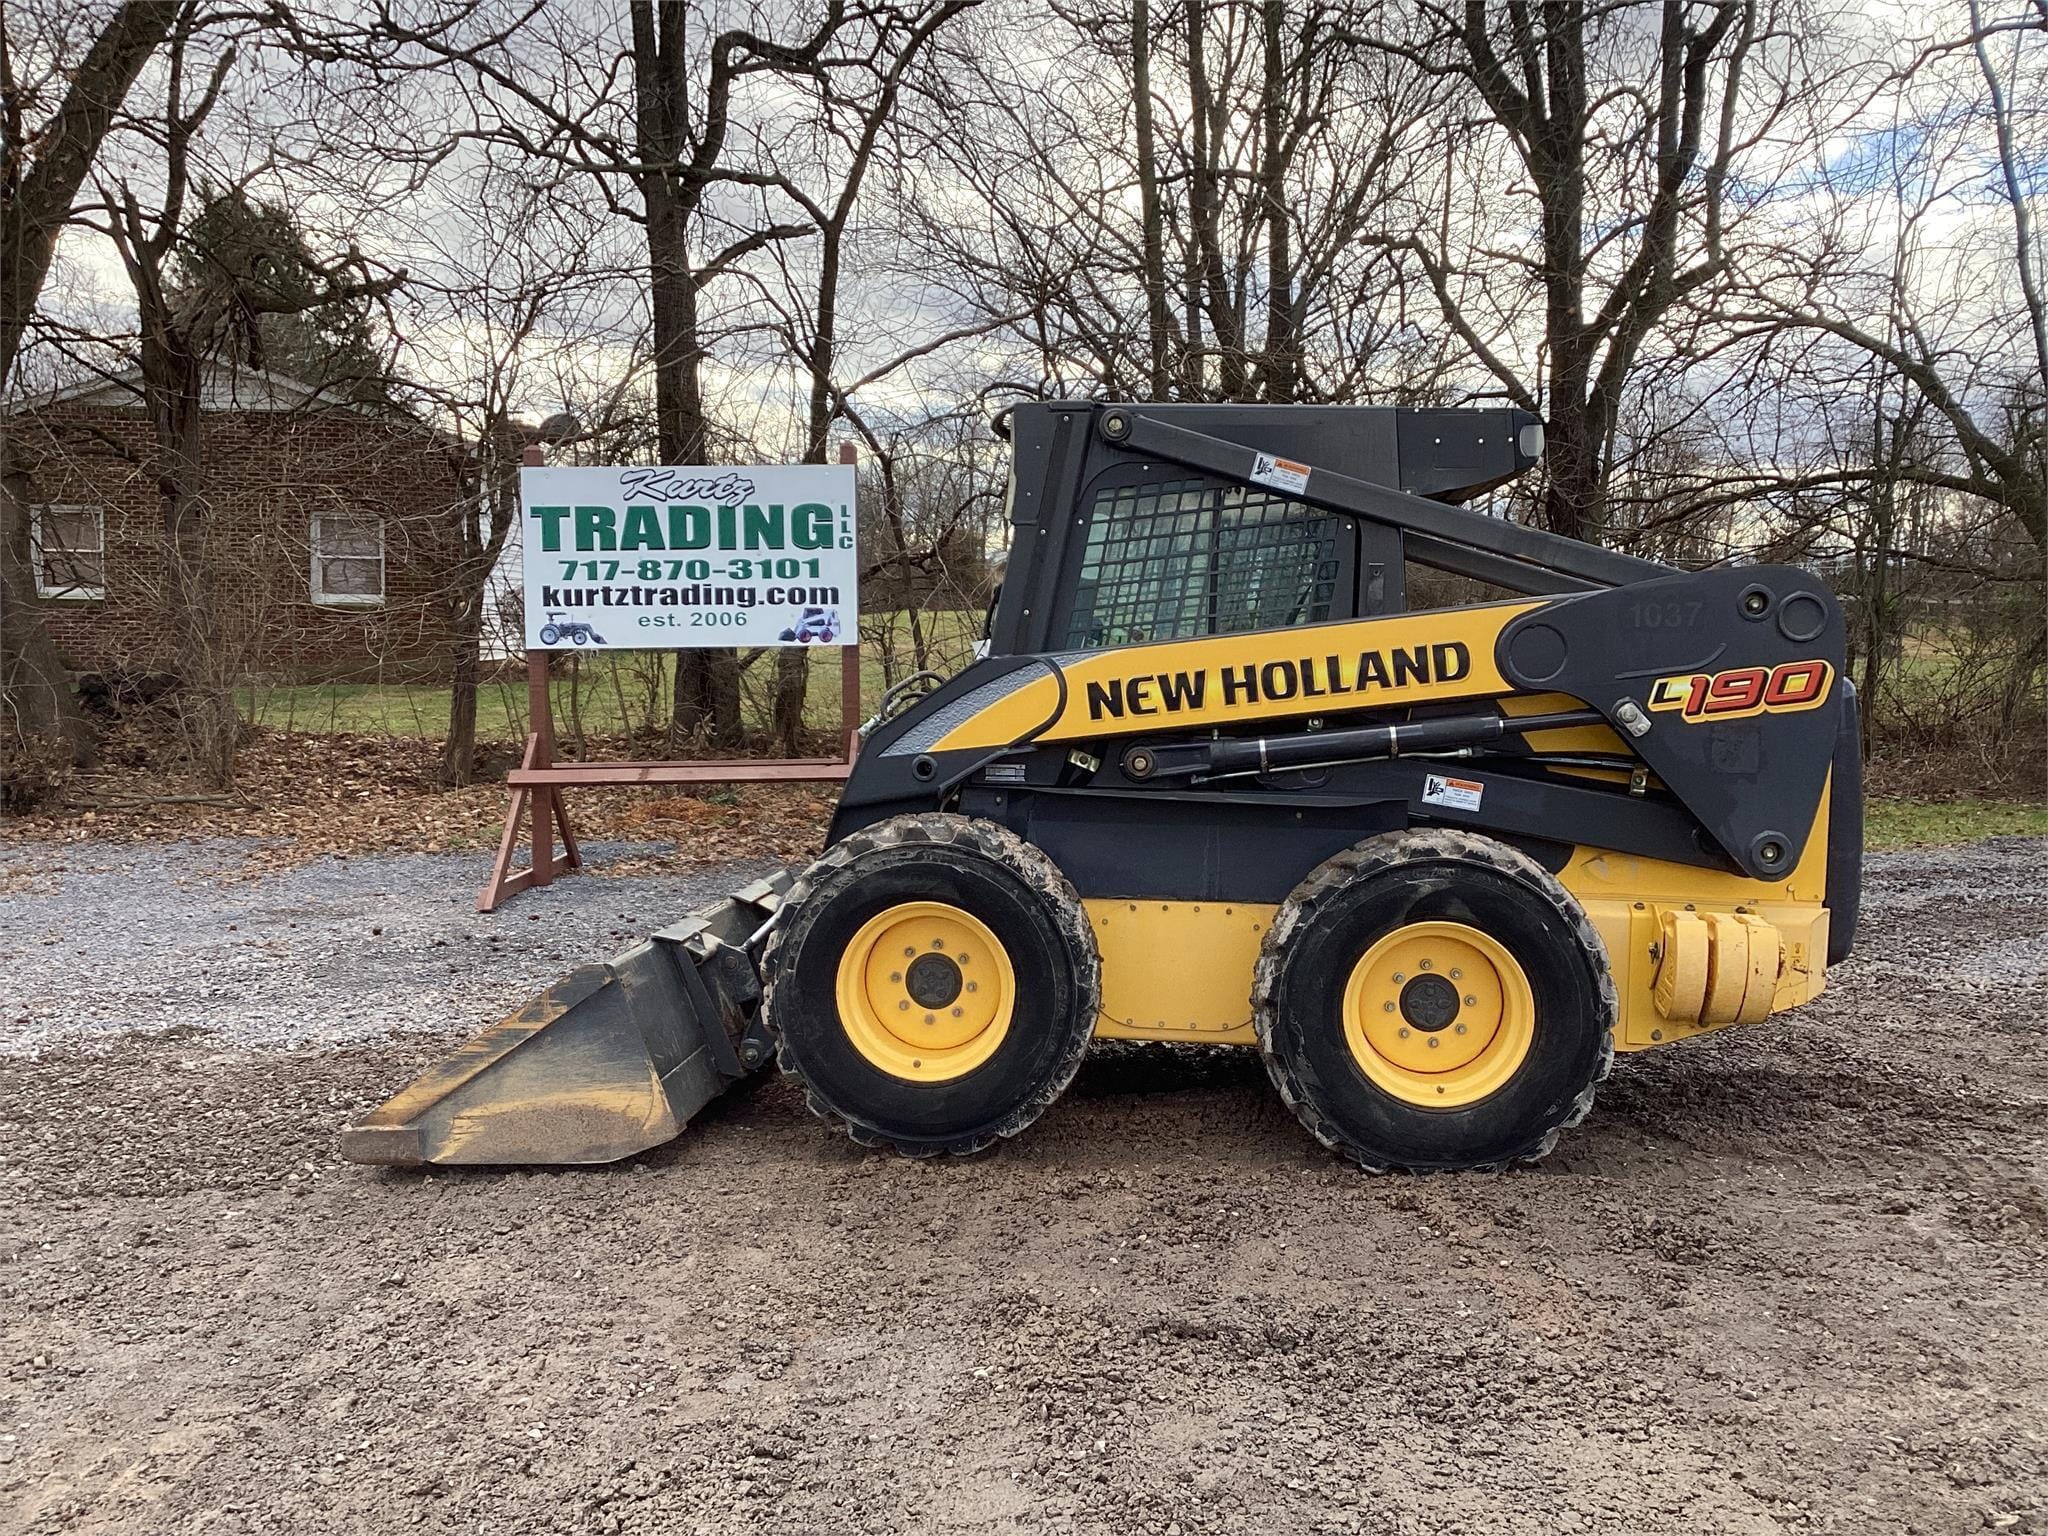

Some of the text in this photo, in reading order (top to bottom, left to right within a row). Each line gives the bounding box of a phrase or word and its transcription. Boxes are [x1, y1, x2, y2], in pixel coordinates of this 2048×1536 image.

[620, 468, 755, 507] Kurtz
[530, 503, 833, 552] TRADING
[839, 504, 853, 549] LLC
[558, 558, 820, 581] 717-870-3101
[542, 584, 839, 607] kurtztrading.com
[638, 612, 747, 627] est. 2006
[1086, 640, 1471, 720] NEW HOLLAND
[1648, 660, 1834, 723] L190
